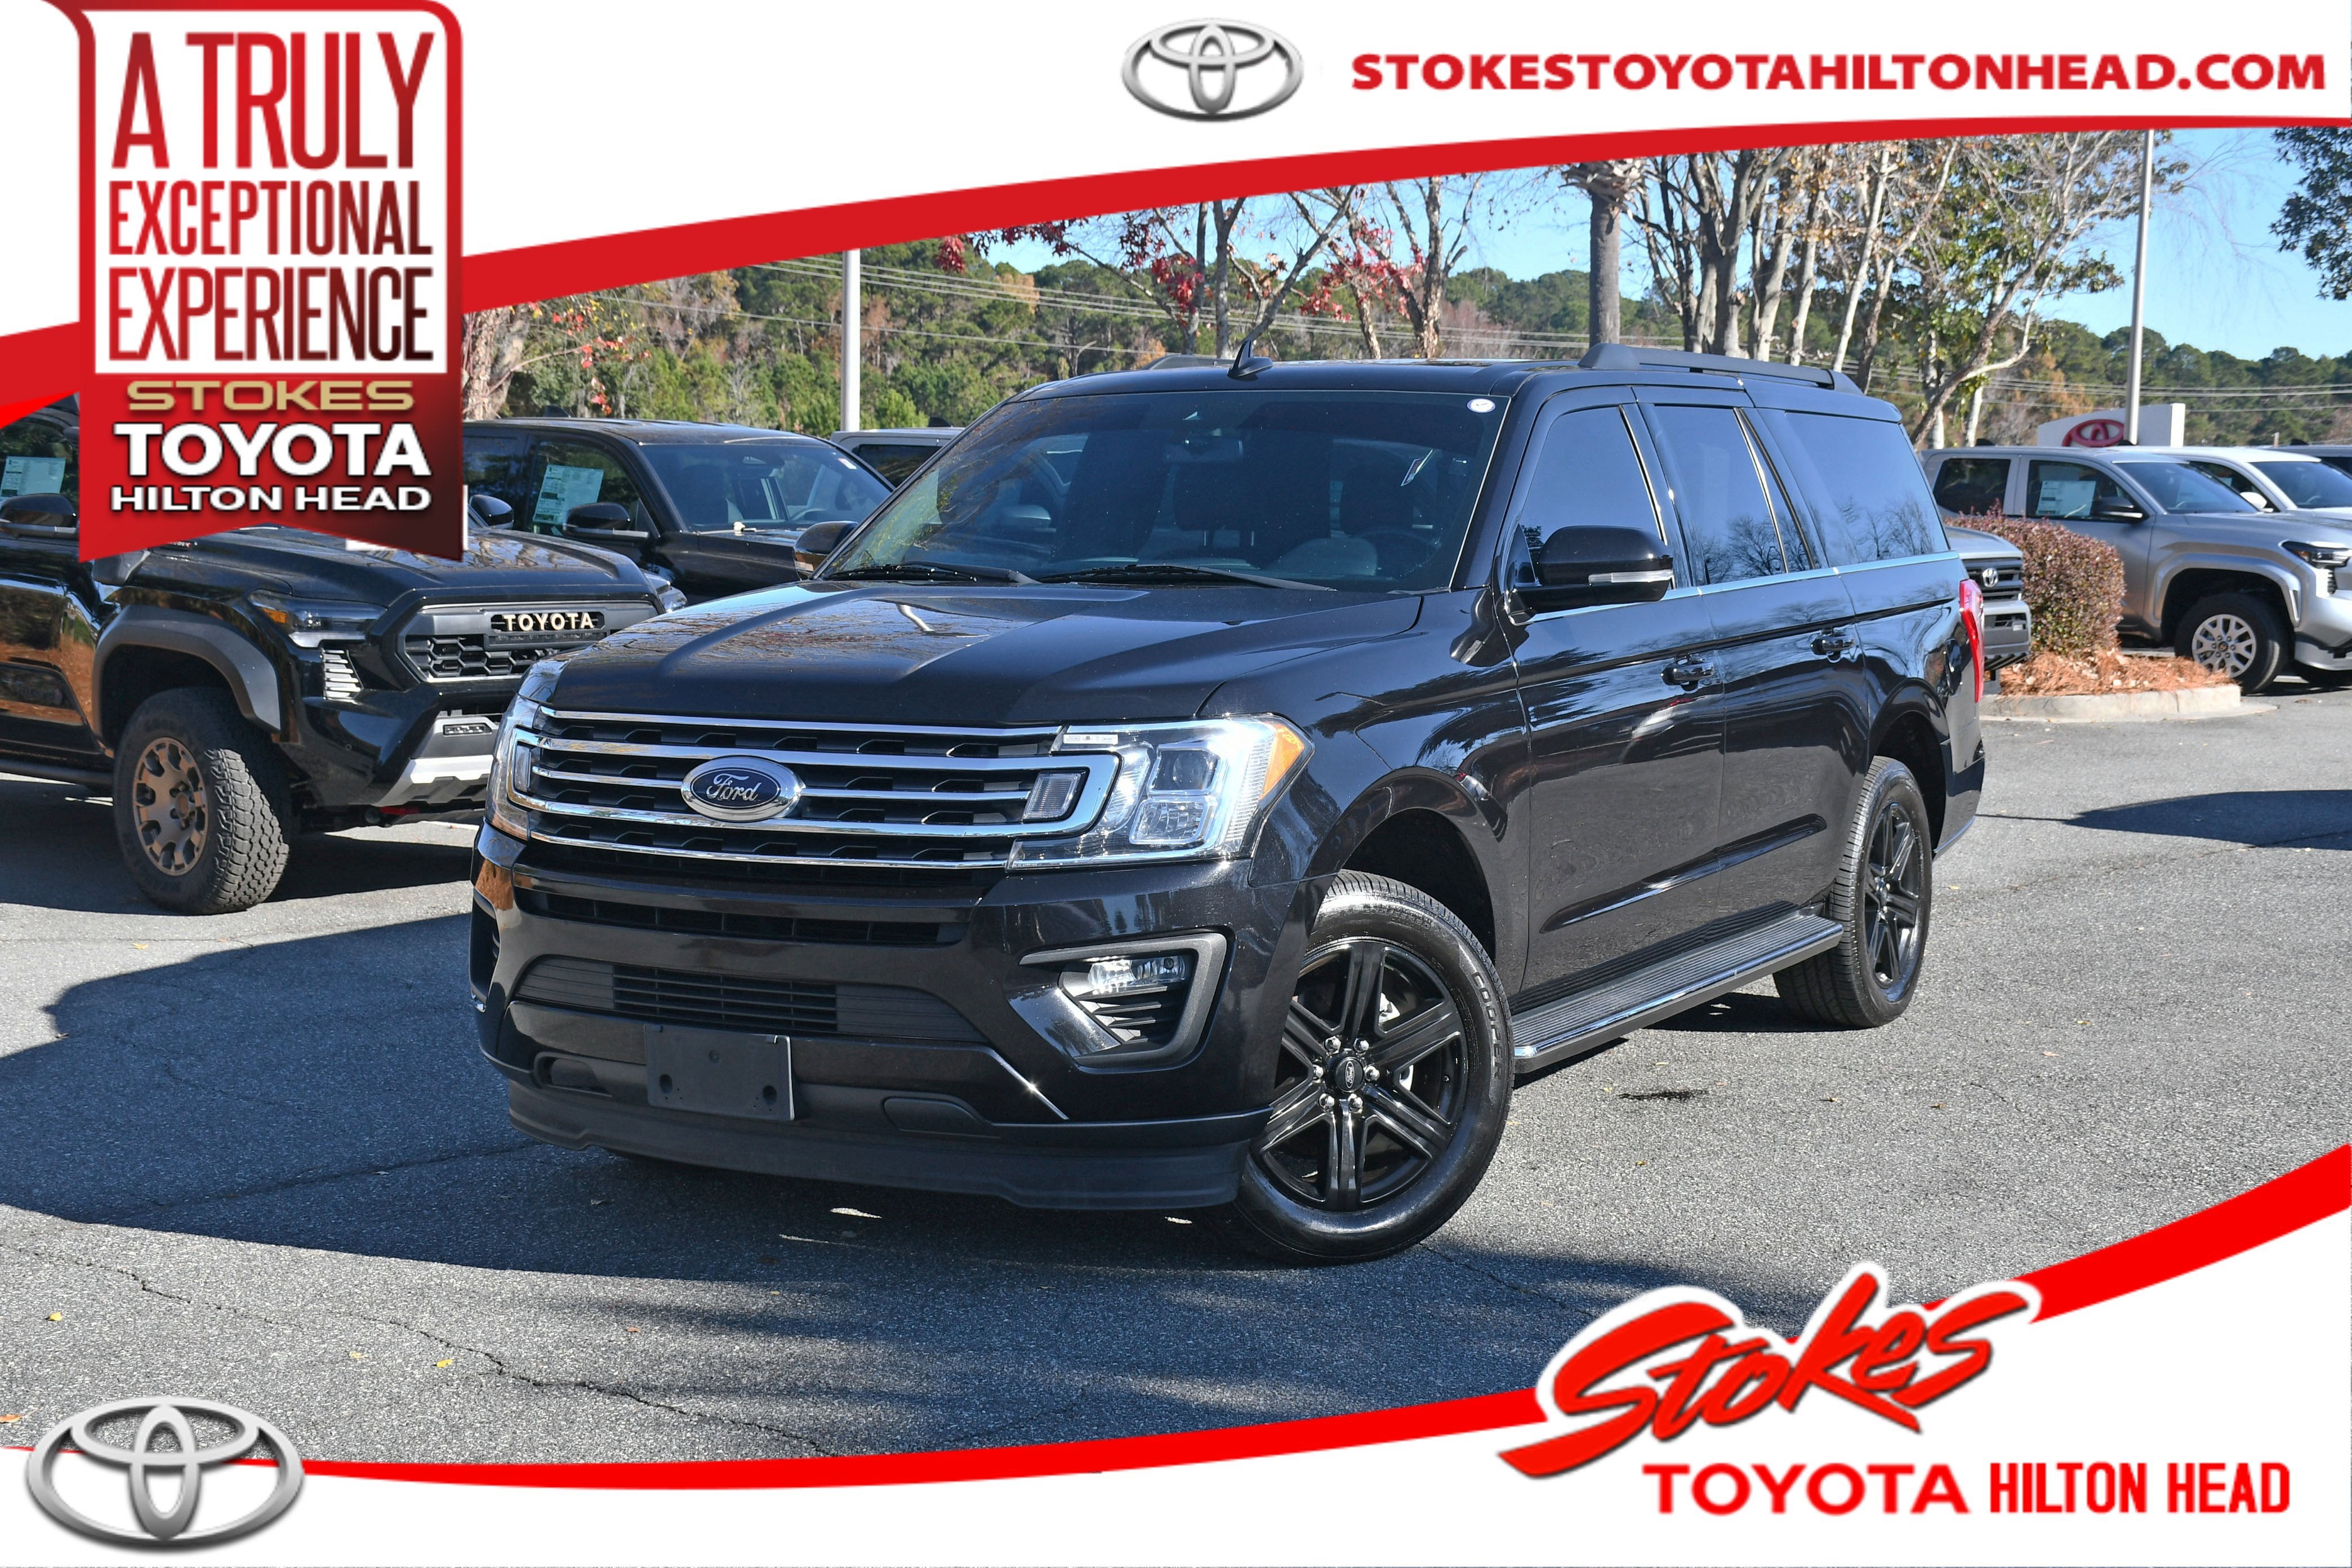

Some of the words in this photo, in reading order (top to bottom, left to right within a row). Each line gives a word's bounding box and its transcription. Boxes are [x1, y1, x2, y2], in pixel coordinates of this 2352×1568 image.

[503, 612, 594, 631] TOYOTA
[706, 773, 761, 801] Ford
[1471, 972, 1502, 1080] COOPER
